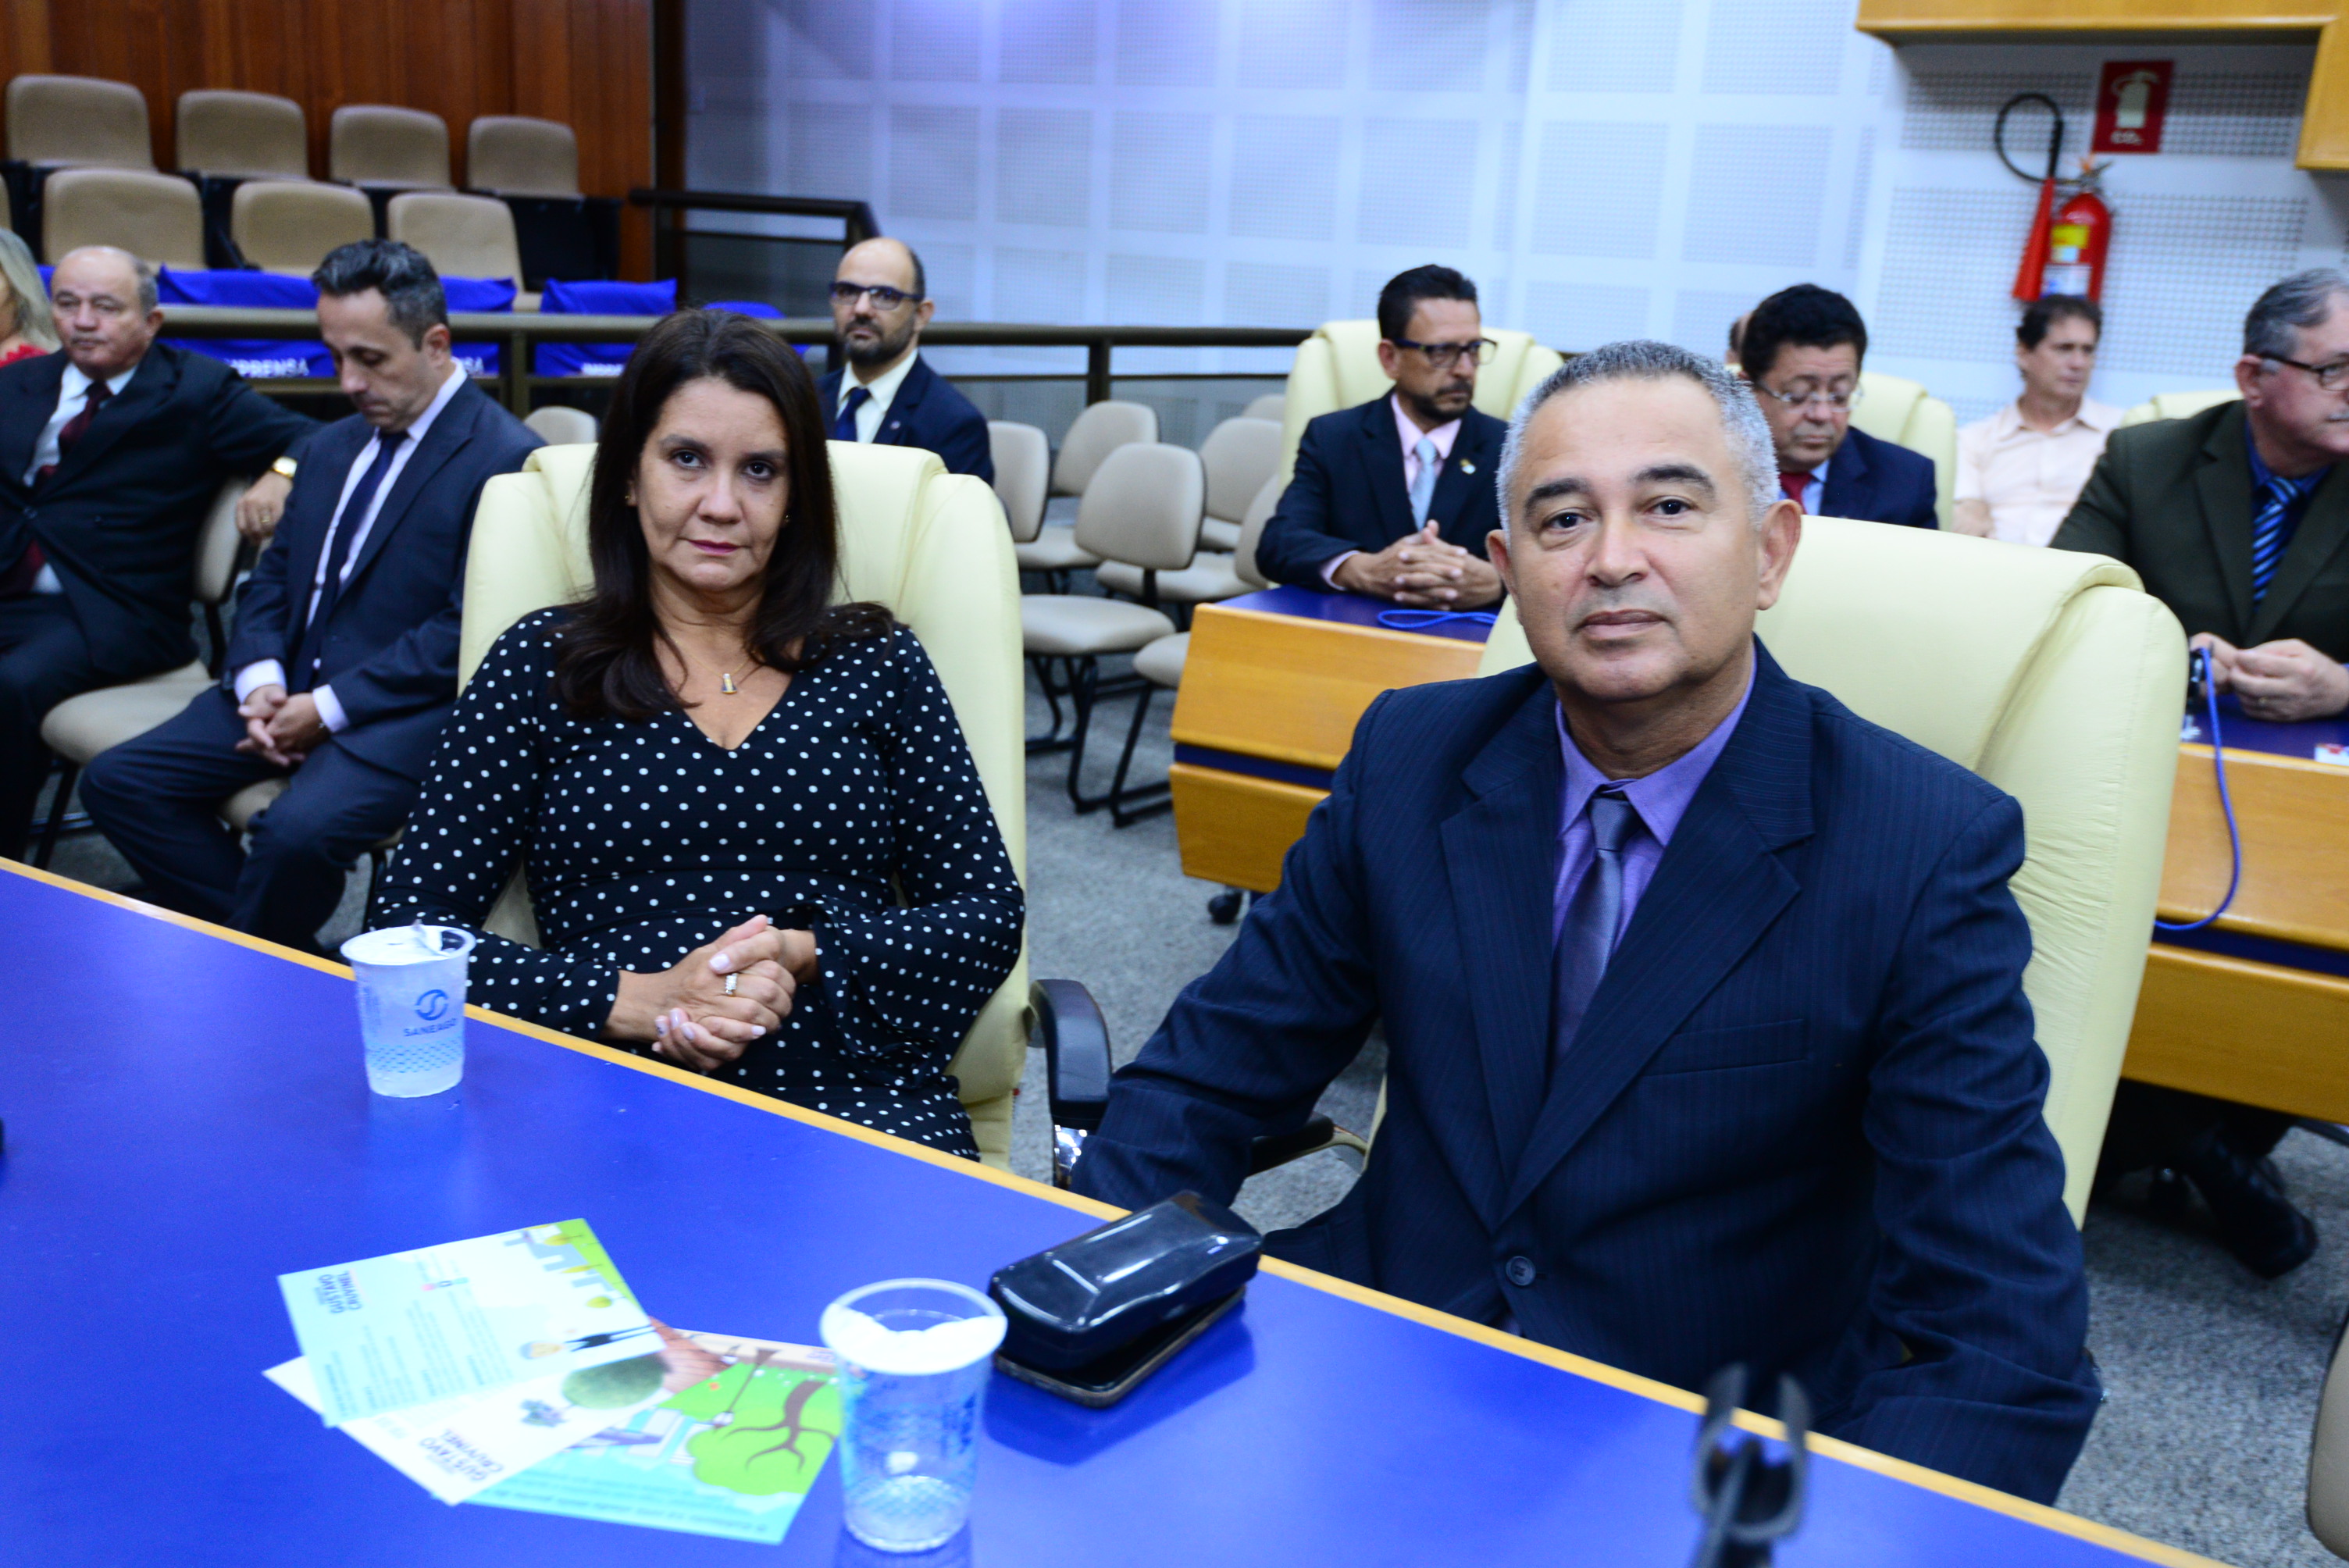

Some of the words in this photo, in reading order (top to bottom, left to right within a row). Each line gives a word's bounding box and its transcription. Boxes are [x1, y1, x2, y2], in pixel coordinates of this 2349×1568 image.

[319, 1274, 345, 1313] GUSTAVO
[337, 1270, 363, 1310] CRUVINEL
[420, 1438, 488, 1481] GUSTAVO
[440, 1428, 504, 1472] CRUVINEL
